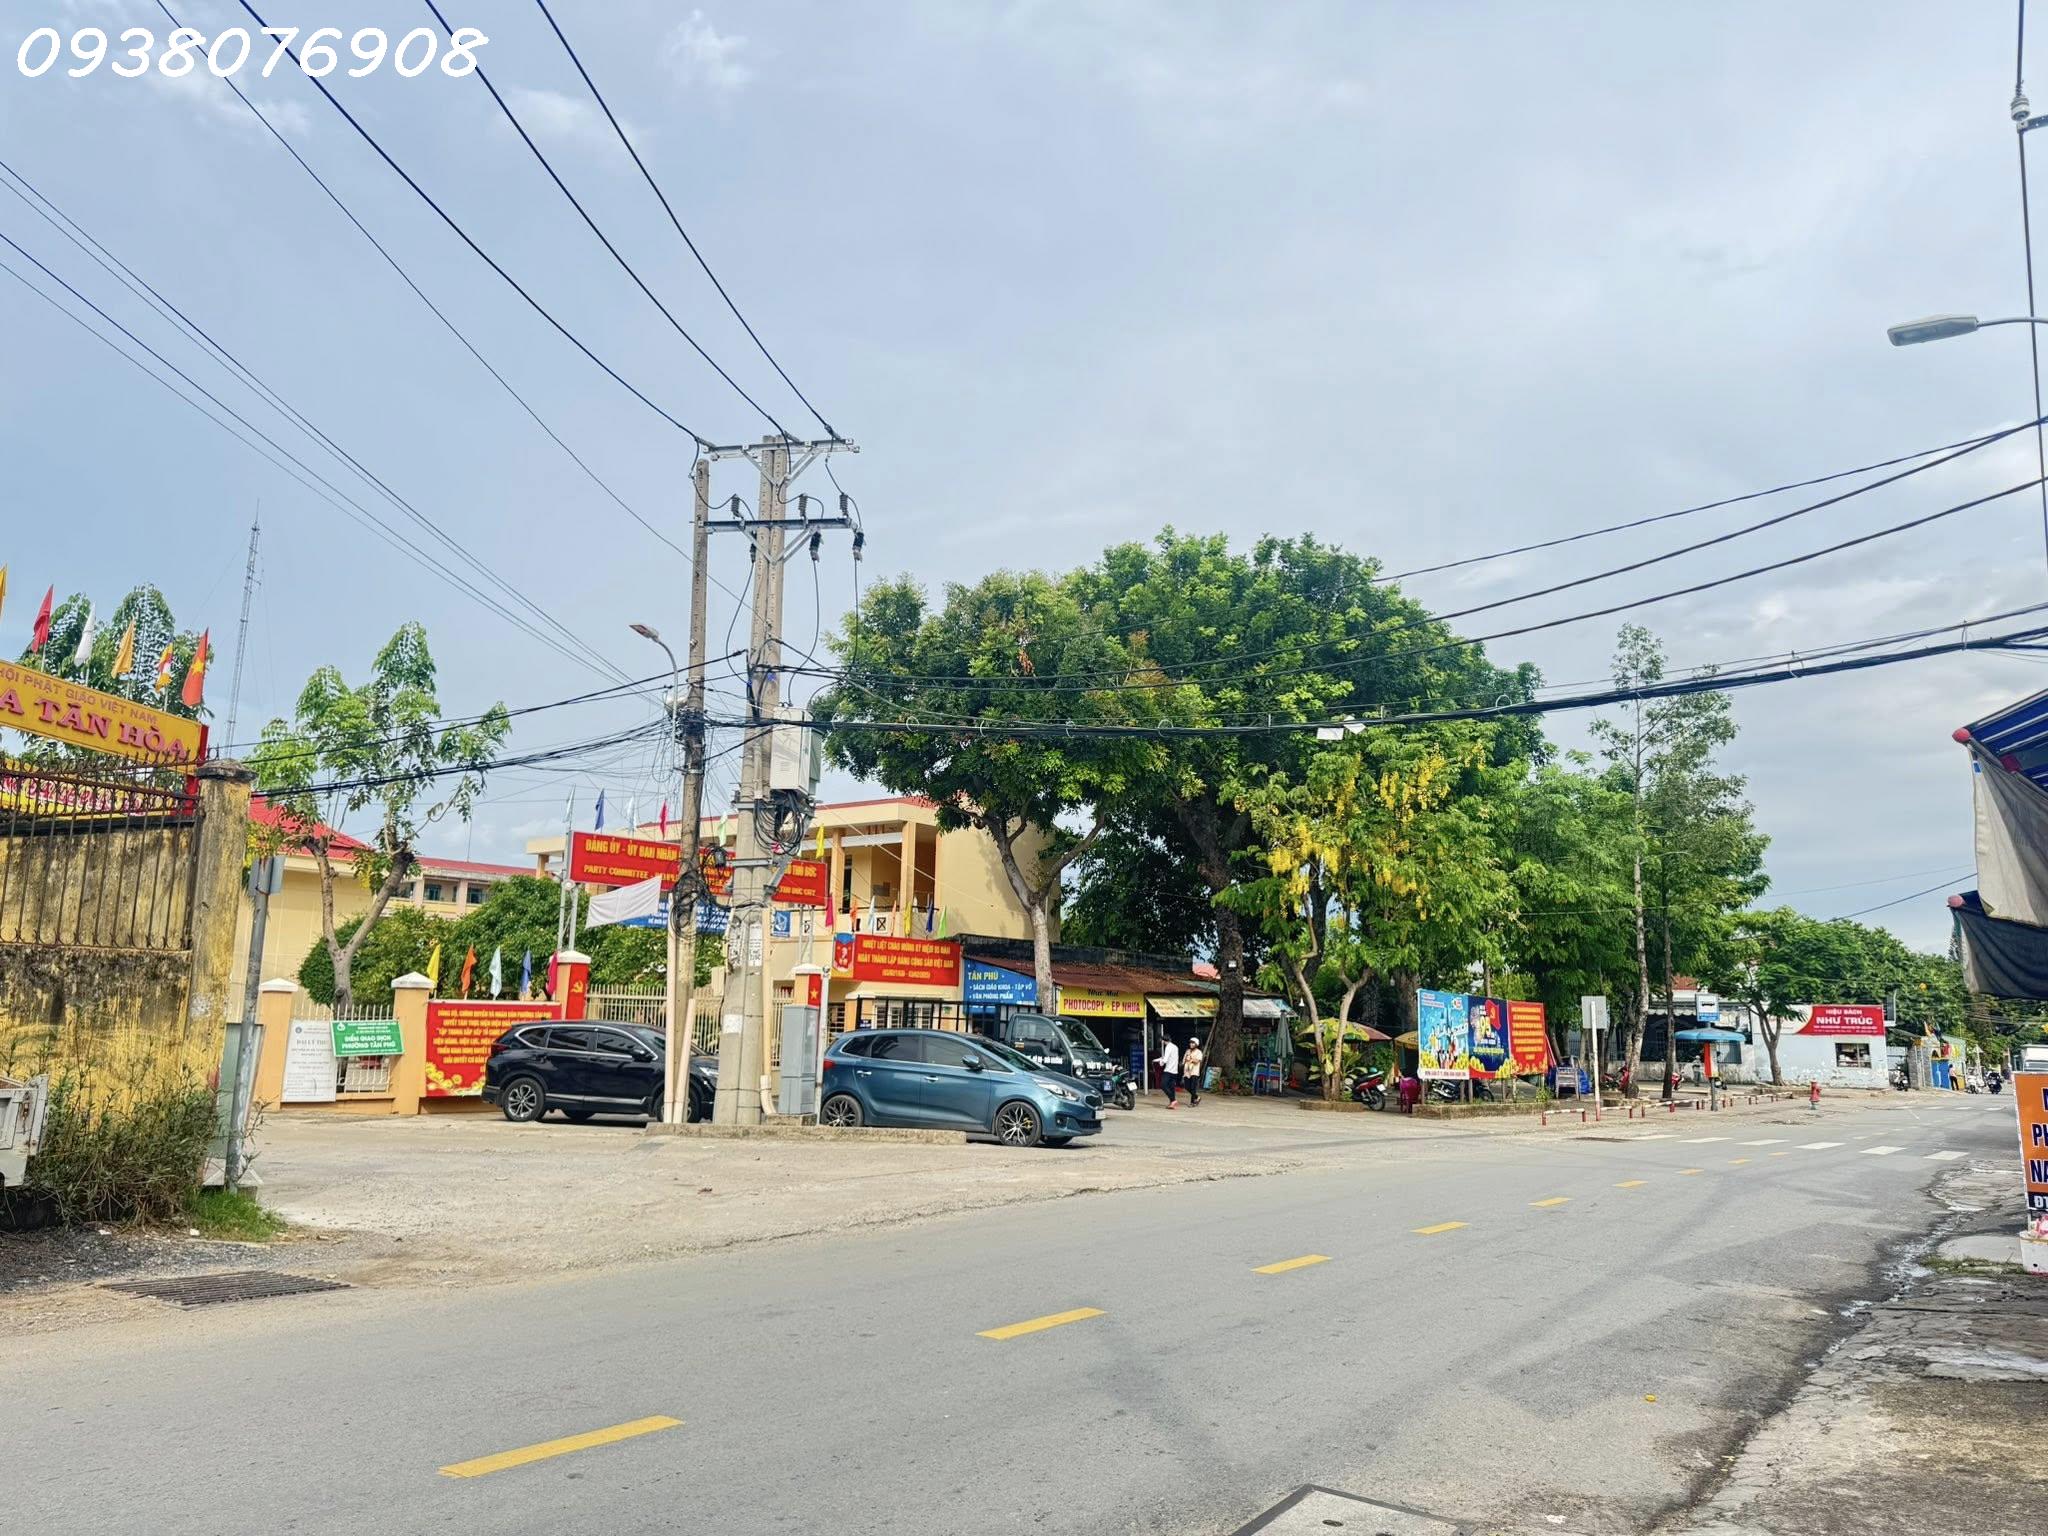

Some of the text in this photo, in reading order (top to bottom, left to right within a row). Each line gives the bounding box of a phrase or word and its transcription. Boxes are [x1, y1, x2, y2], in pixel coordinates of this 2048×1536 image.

[24, 674, 61, 694] PHẬT
[66, 688, 96, 705] GIÁO
[100, 698, 126, 714] VIỆT
[130, 709, 157, 723] NAM
[35, 699, 111, 739] TÂN
[118, 723, 188, 760] HÒA
[639, 846, 655, 858] BAN
[584, 864, 607, 874] PARTY
[609, 867, 649, 878] COMMITTEE
[968, 969, 998, 980] TÂN PHÚ
[1064, 999, 1104, 1011] PHOTOCOPY
[1816, 1015, 1873, 1024] NHƯ TRÚC
